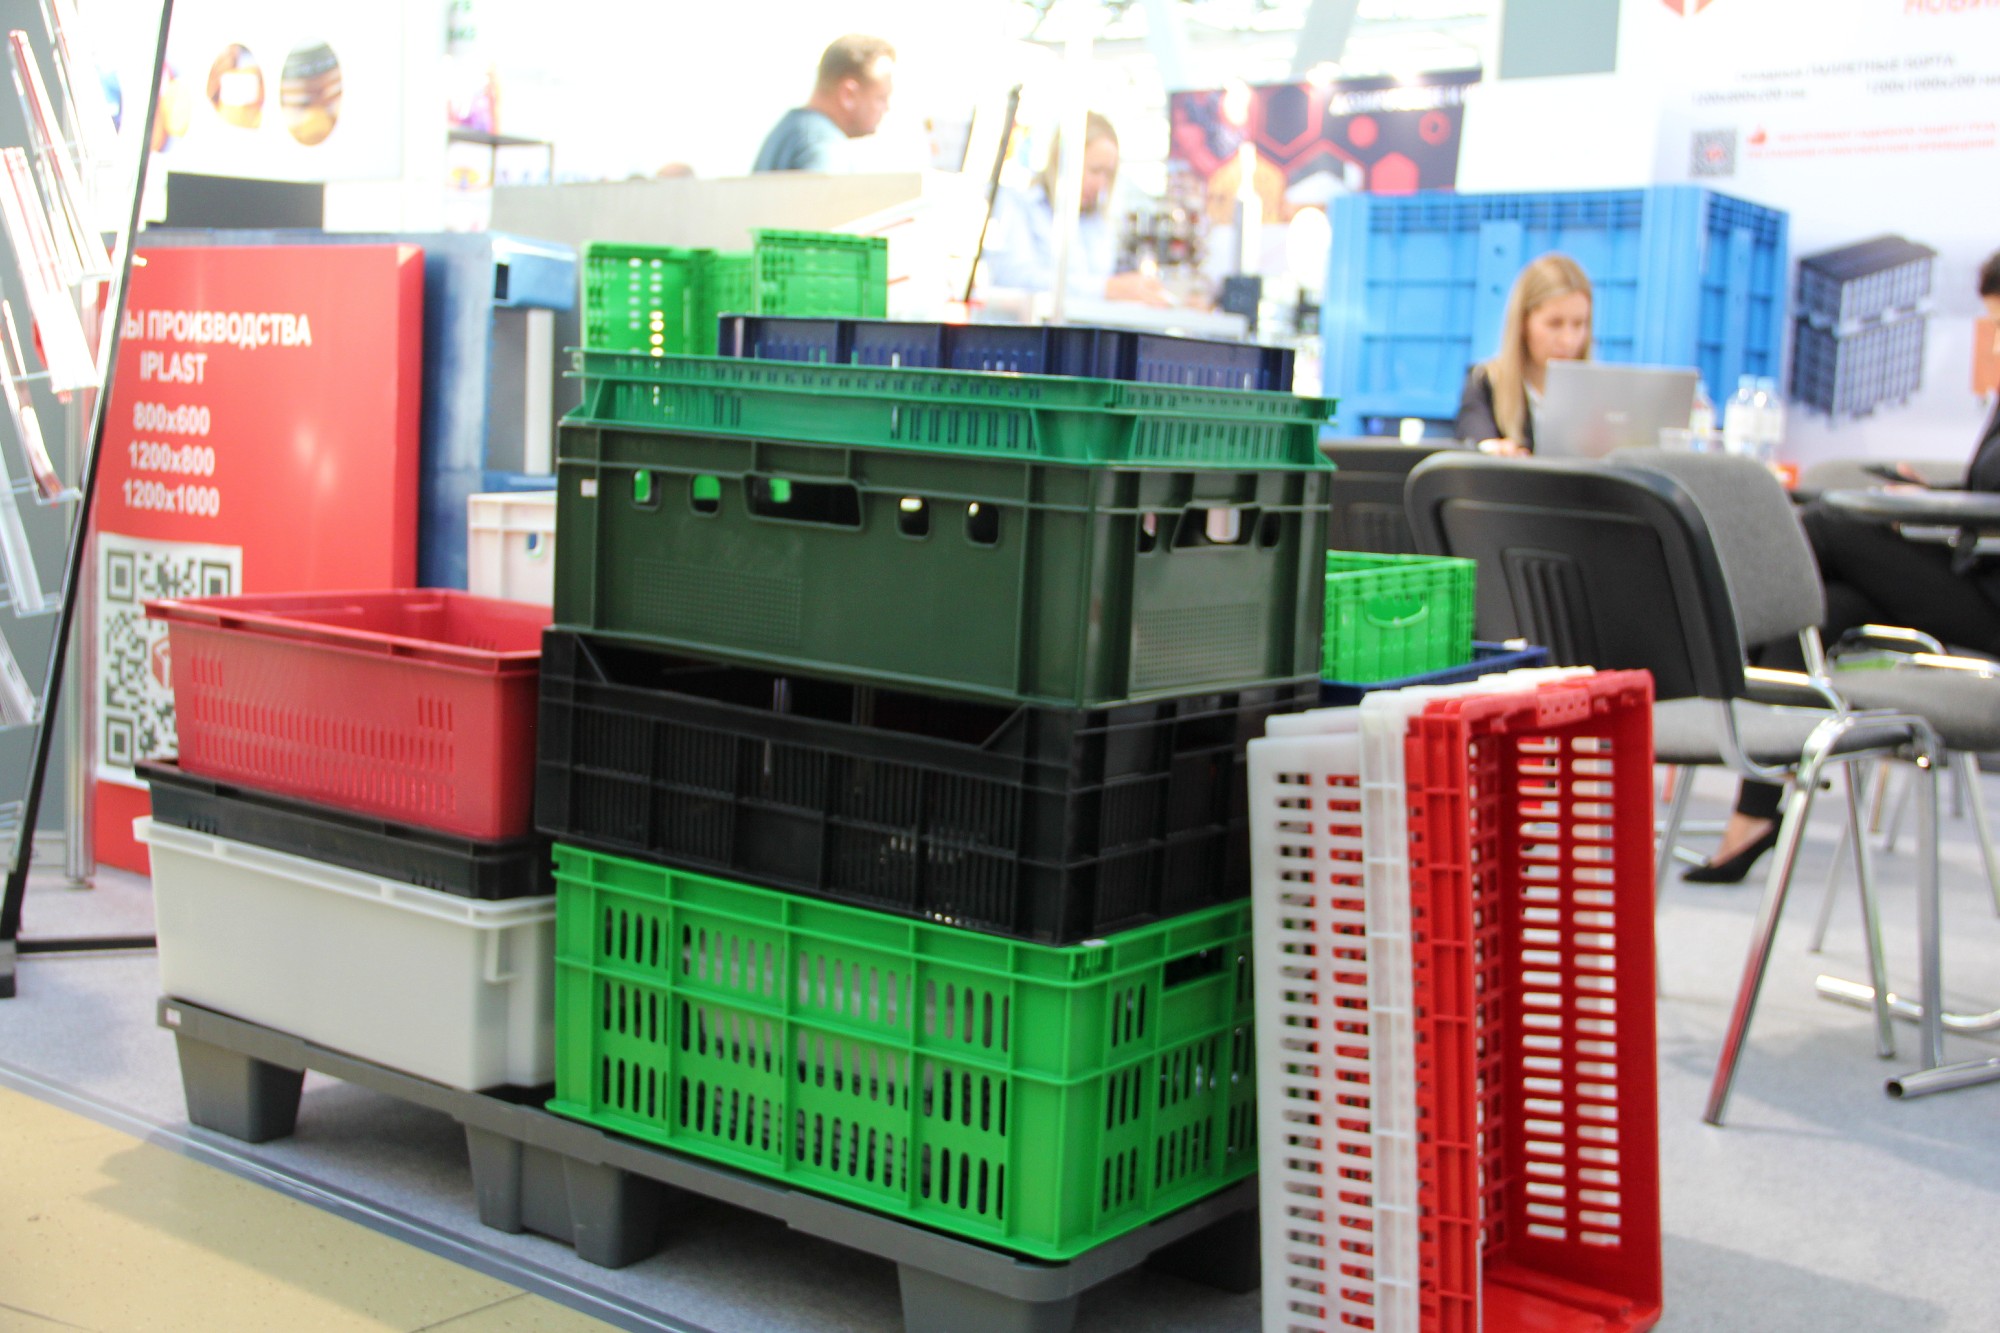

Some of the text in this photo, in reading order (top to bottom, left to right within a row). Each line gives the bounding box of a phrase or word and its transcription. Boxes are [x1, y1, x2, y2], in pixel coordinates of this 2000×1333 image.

[147, 309, 312, 350] ПРОИЗВОДСТВА
[139, 351, 208, 384] IPLAST
[133, 400, 211, 437] 800x600
[128, 440, 216, 477] 1200x800
[122, 478, 220, 517] 1200x1000
